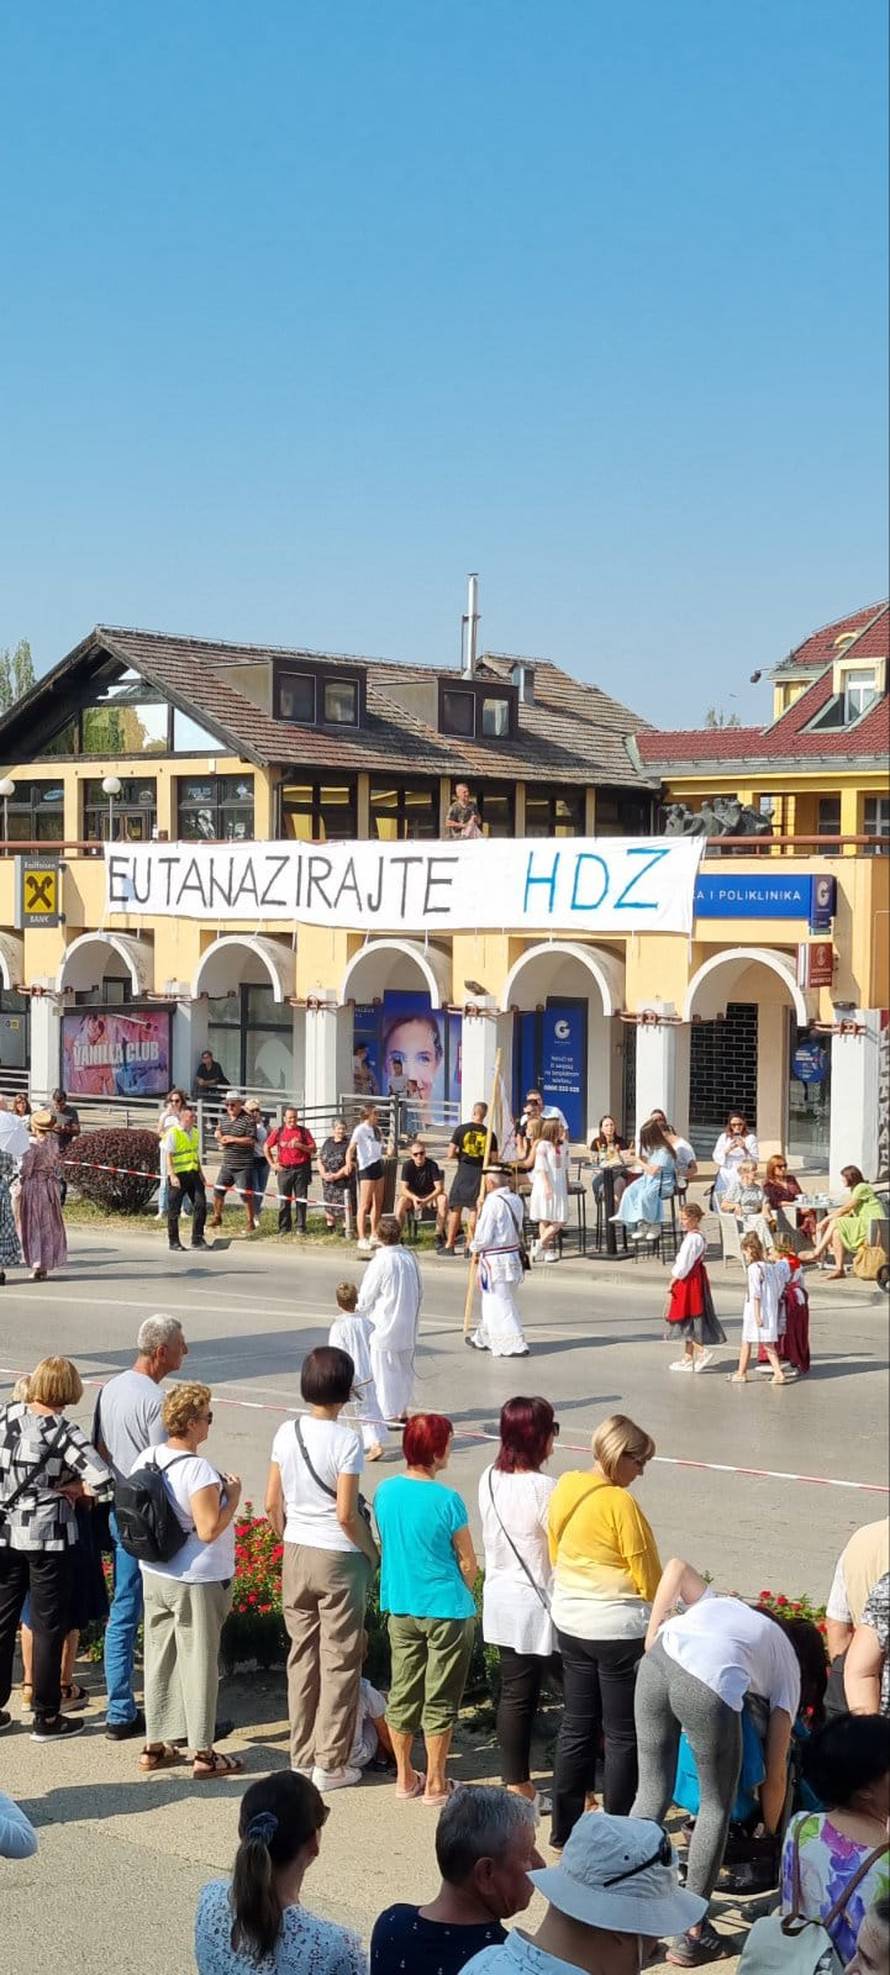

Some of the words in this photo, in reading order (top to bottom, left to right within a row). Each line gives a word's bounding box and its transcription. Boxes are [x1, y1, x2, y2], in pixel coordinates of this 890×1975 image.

[109, 855, 459, 918] EUTANAZIRAJTE
[524, 848, 671, 913] HDZ
[719, 889, 801, 901] POLIKLINIKA
[73, 1042, 123, 1067] VANILLA
[126, 1041, 160, 1063] CLUB
